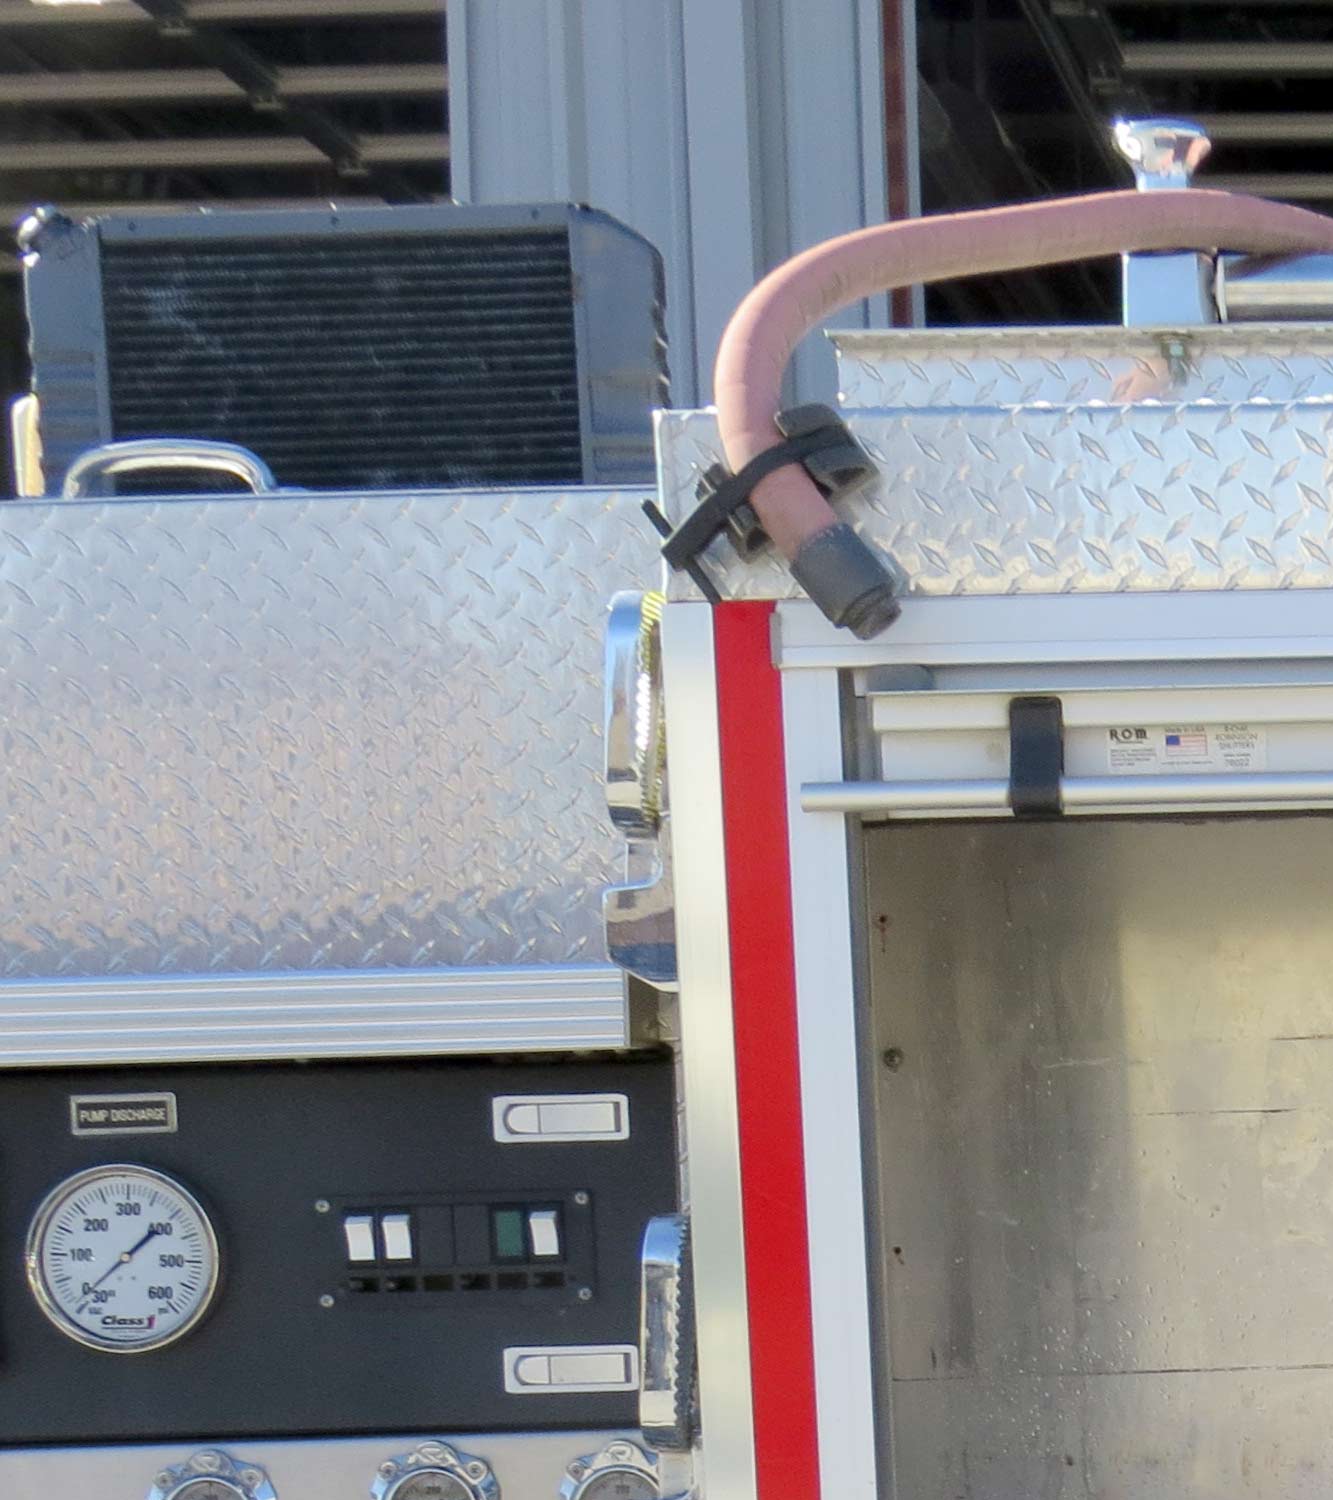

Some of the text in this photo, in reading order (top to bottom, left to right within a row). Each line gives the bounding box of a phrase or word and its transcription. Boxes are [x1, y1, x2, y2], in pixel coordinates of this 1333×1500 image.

[80, 1107, 166, 1123] PUMP DISCHARGE
[115, 1202, 141, 1216] 300
[83, 1219, 109, 1232] 200
[148, 1222, 173, 1236] 400
[71, 1248, 92, 1262] 100
[159, 1254, 184, 1268] 500
[148, 1286, 173, 1300] 600
[101, 1315, 145, 1326] Class
